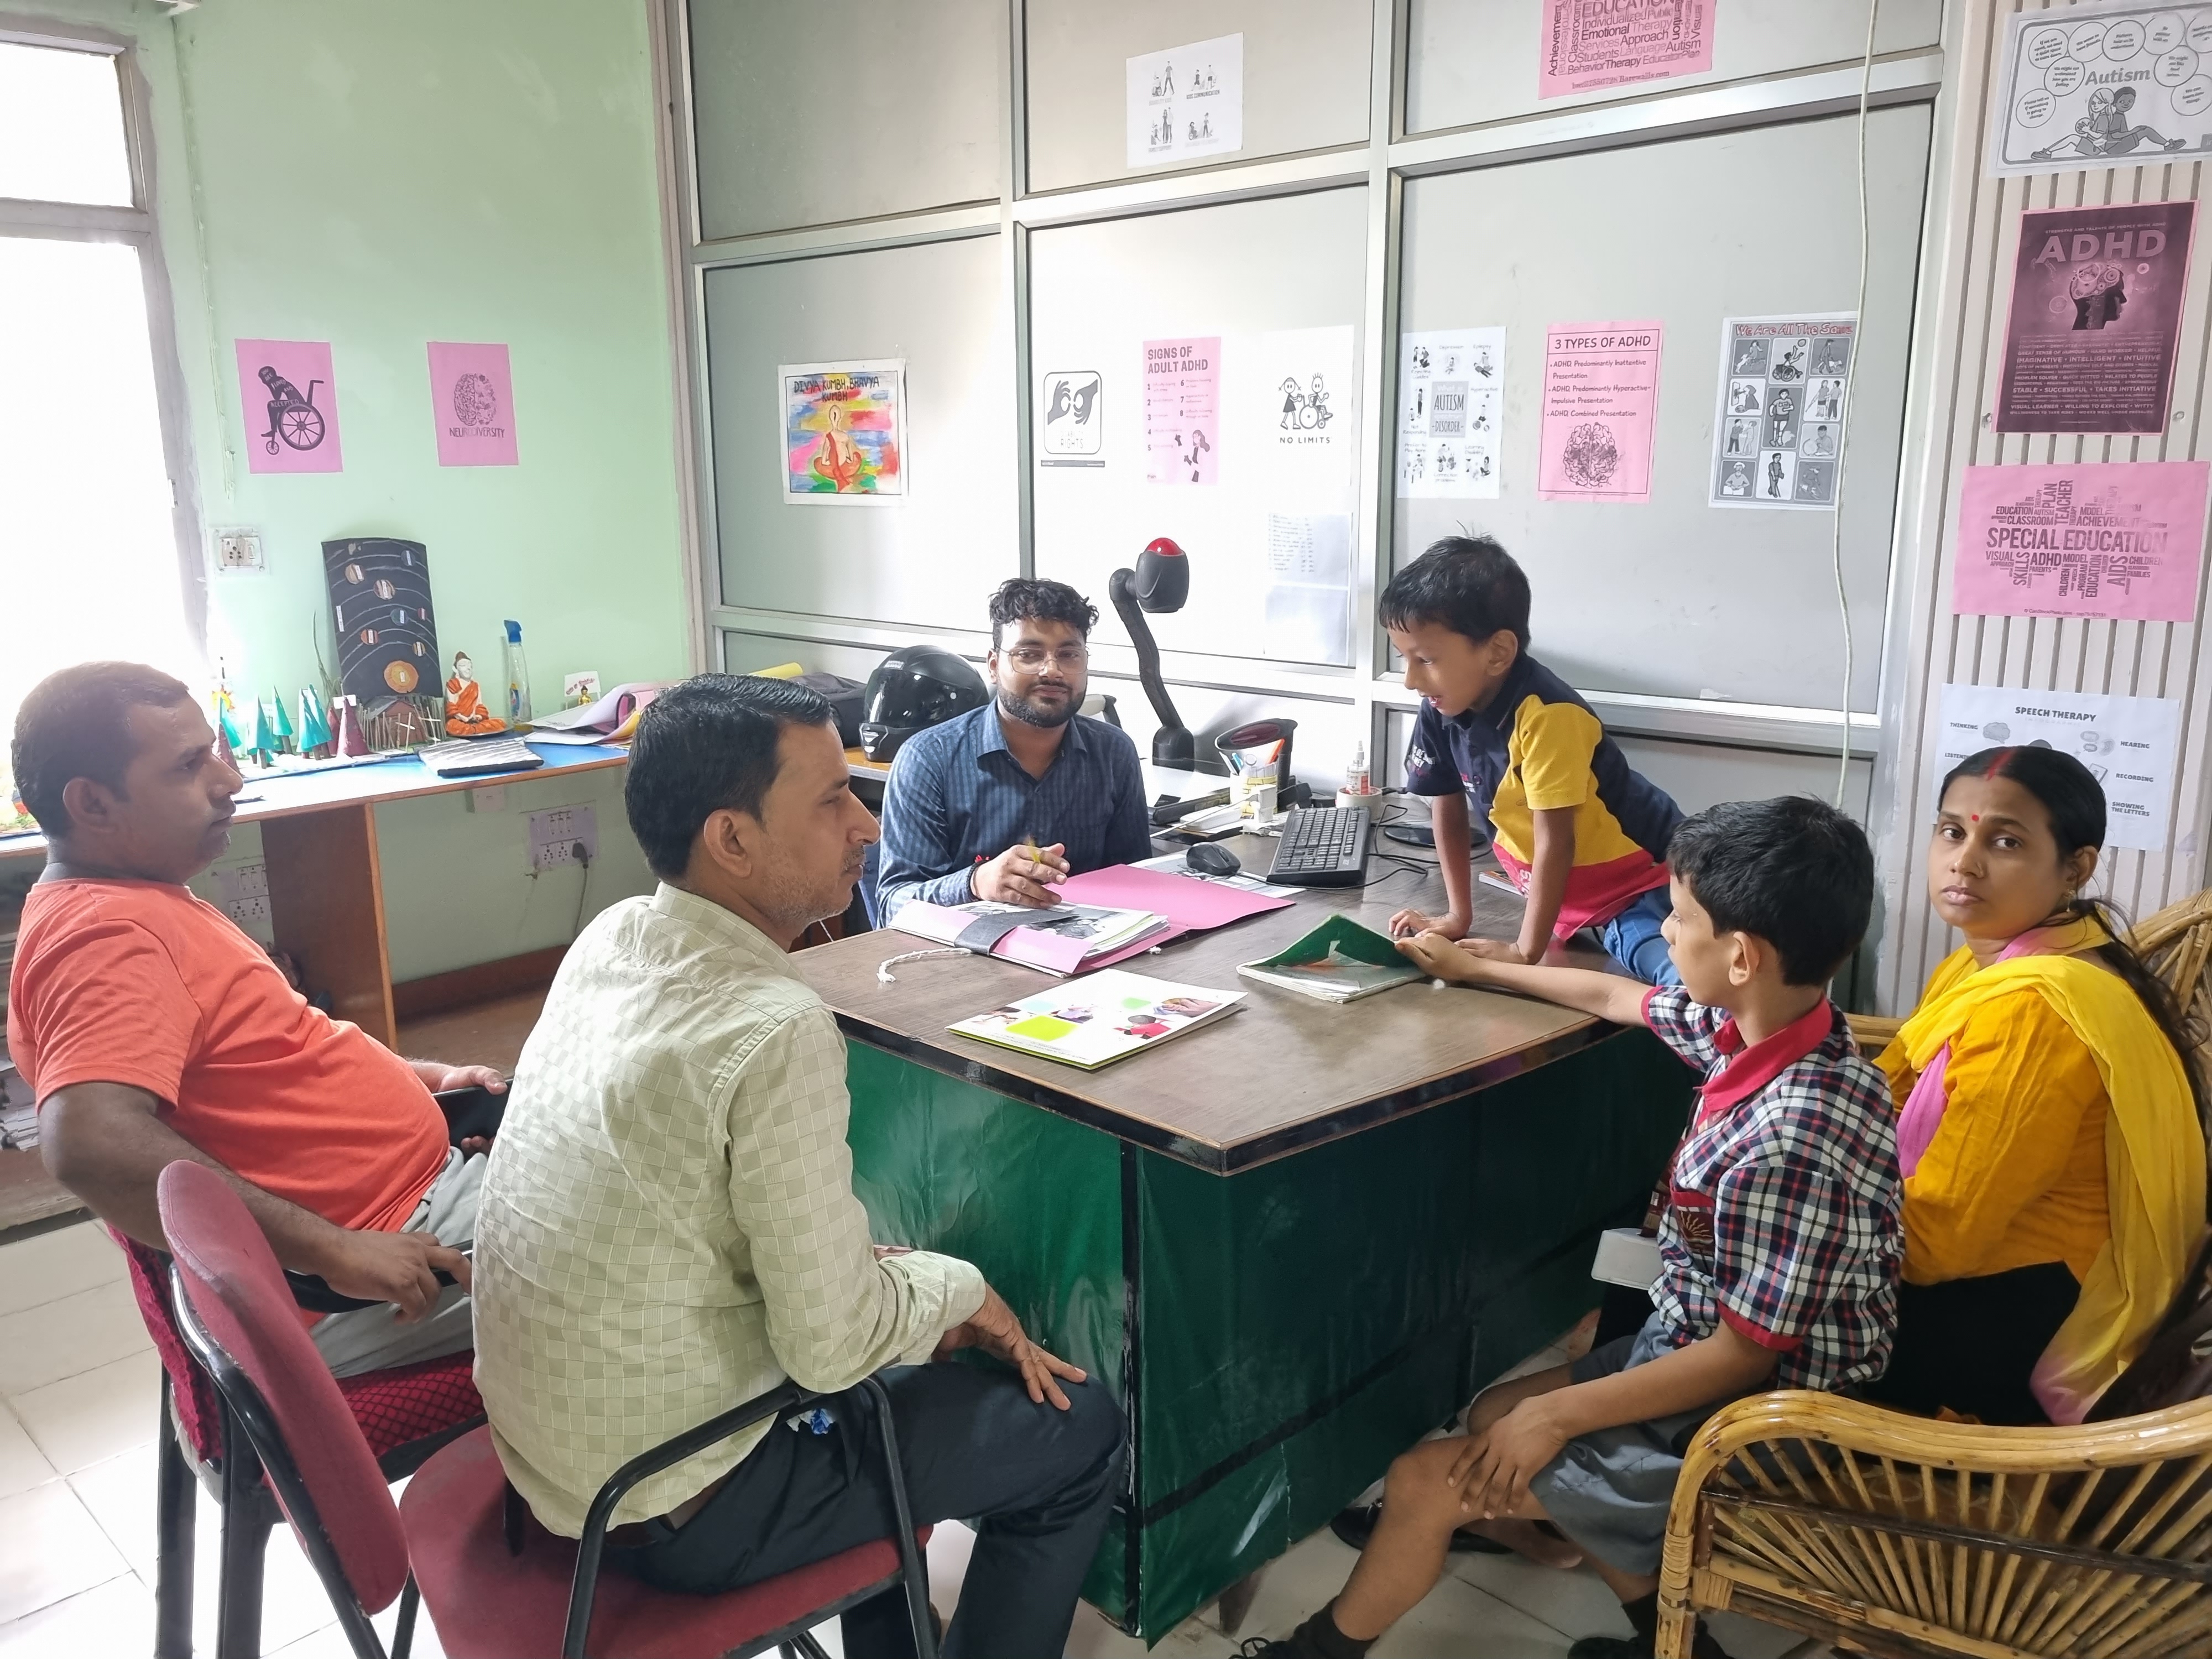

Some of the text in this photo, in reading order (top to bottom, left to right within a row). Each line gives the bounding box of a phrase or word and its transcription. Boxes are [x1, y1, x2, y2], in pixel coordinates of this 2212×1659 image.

[1582, 0, 1674, 18] EDUCA
[1581, 23, 1630, 40] Emotional
[1631, 19, 1672, 33] Therapy
[1578, 29, 1668, 51] Services Approach
[1577, 39, 1701, 63] Students Language Autism
[1568, 61, 1606, 75] Behavior
[1605, 57, 1641, 70] Therapy
[2084, 67, 2151, 86] Autism
[2035, 230, 2167, 263] ADHD
[1735, 325, 1752, 336] We
[1754, 325, 1777, 336] Are
[1778, 324, 1794, 336] All
[1796, 323, 1818, 336] The
[1554, 336, 1651, 349] 3 TYPES OF ADHD
[1147, 346, 1192, 360] SIGNS OF
[1147, 359, 1208, 374] ADULT ADHD
[273, 379, 286, 387] LOVED
[794, 380, 820, 393] DIVYA
[849, 376, 880, 390] BHAVYA
[270, 399, 299, 408] ACCEPTED
[822, 392, 848, 402] KUMBH
[1433, 393, 1464, 410] AUTISM
[449, 426, 505, 438] NEURODIVERSITY
[1435, 421, 1460, 432] DISORDER
[1061, 438, 1083, 449] RIGHTS
[2042, 483, 2057, 509] PLAN
[2054, 479, 2073, 525] TEACHER
[1995, 506, 2033, 515] EDUCATION
[2080, 507, 2106, 515] MODEL
[2007, 515, 2054, 525] CLASSROOM
[1986, 527, 2168, 552] SPECIAL EDUCATION
[1986, 551, 2014, 561] VISUAL
[2030, 552, 2062, 566] ADHD
[2063, 554, 2088, 563] MODEL
[2013, 551, 2030, 586] SKILLS
[2085, 554, 2102, 597] EDUCATION
[2107, 555, 2128, 587] AIDS
[2058, 568, 2070, 597] CHILDREN
[2077, 564, 2088, 591] PROGRAM
[2015, 707, 2096, 722] SPEECH THERAPY
[2116, 773, 2153, 782] RECORDING
[2112, 801, 2145, 810] SHOWING
